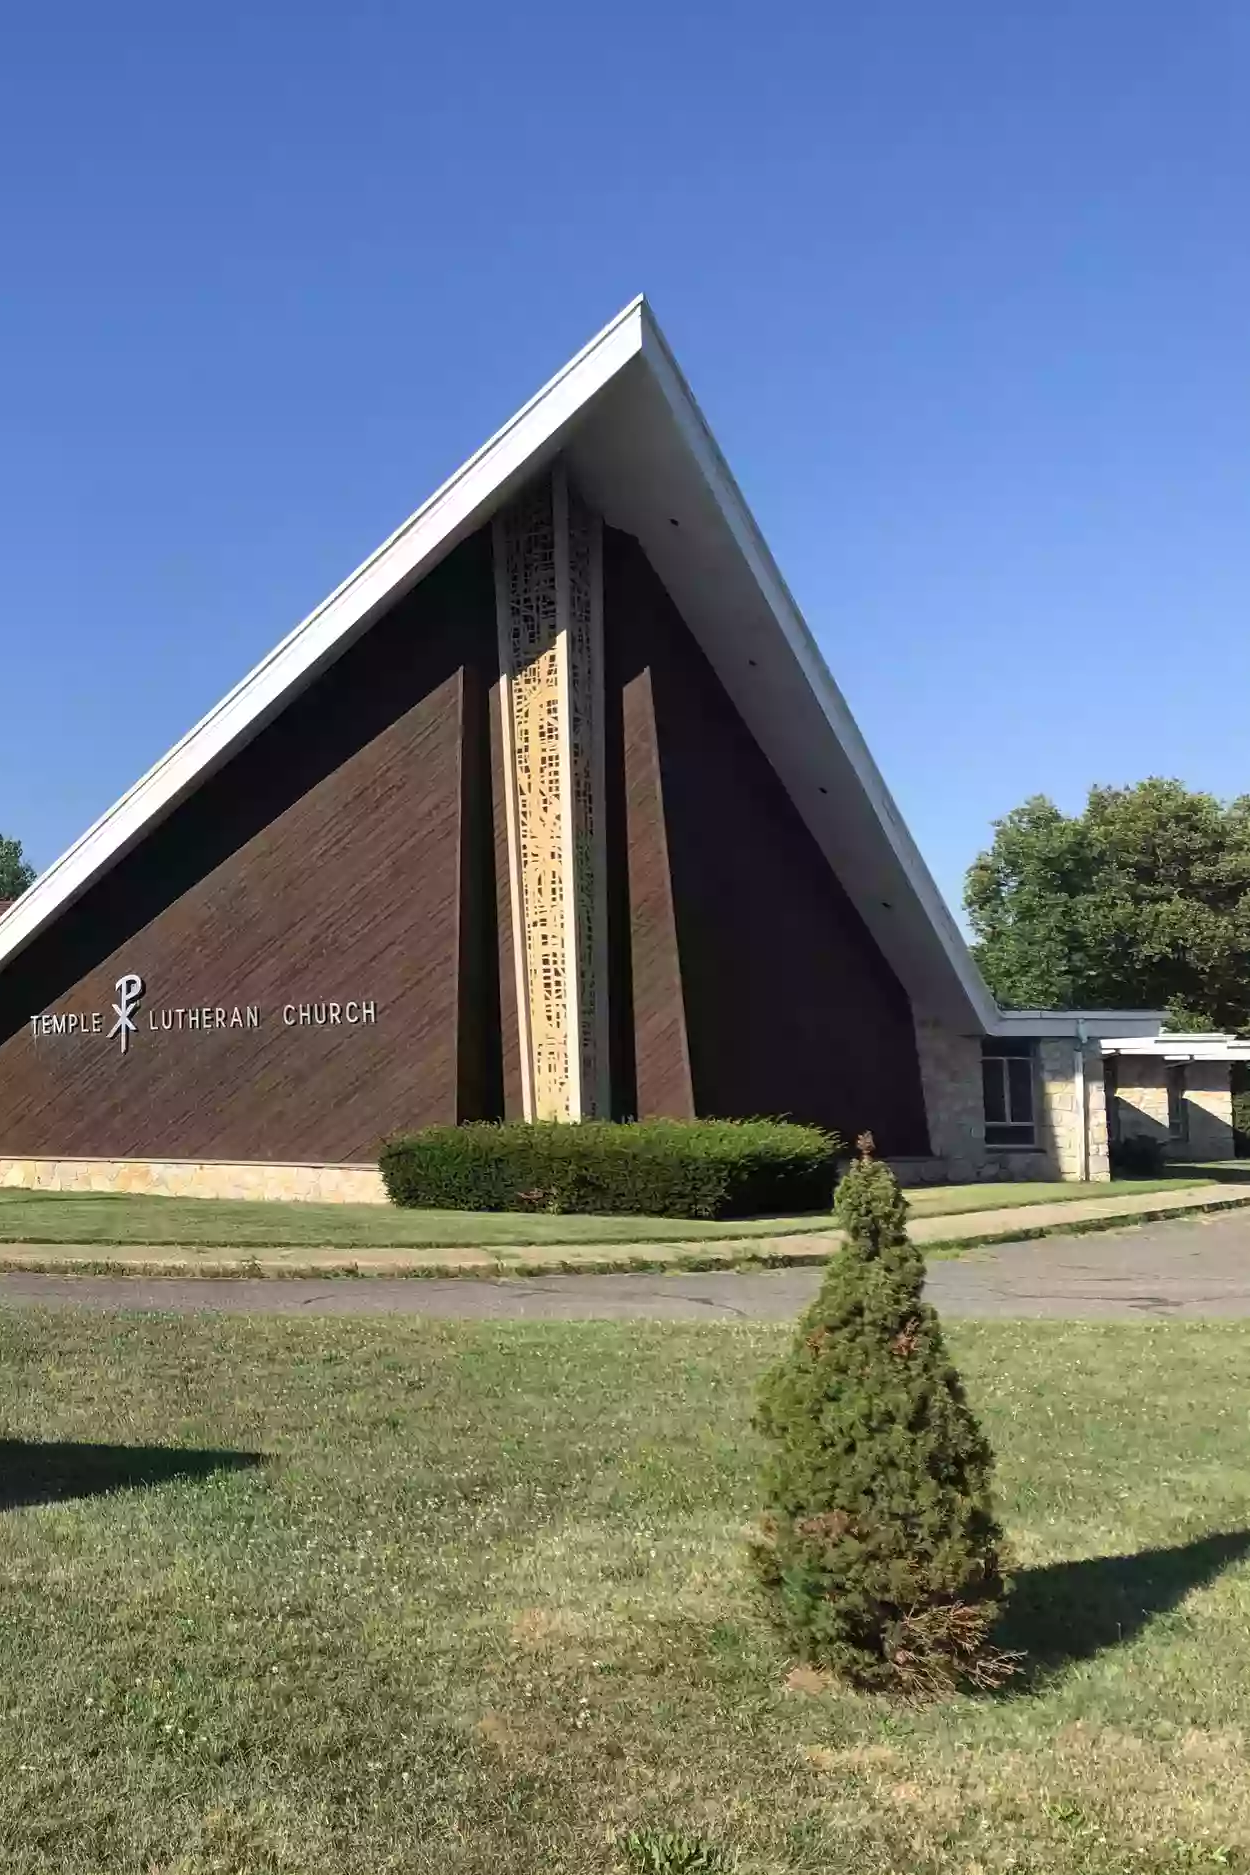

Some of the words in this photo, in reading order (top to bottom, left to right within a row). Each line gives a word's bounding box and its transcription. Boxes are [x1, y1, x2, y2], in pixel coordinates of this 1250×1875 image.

[30, 1012, 102, 1036] TEMPLE
[149, 1006, 260, 1030] LUTHERAN
[283, 1001, 377, 1026] CHURCH
